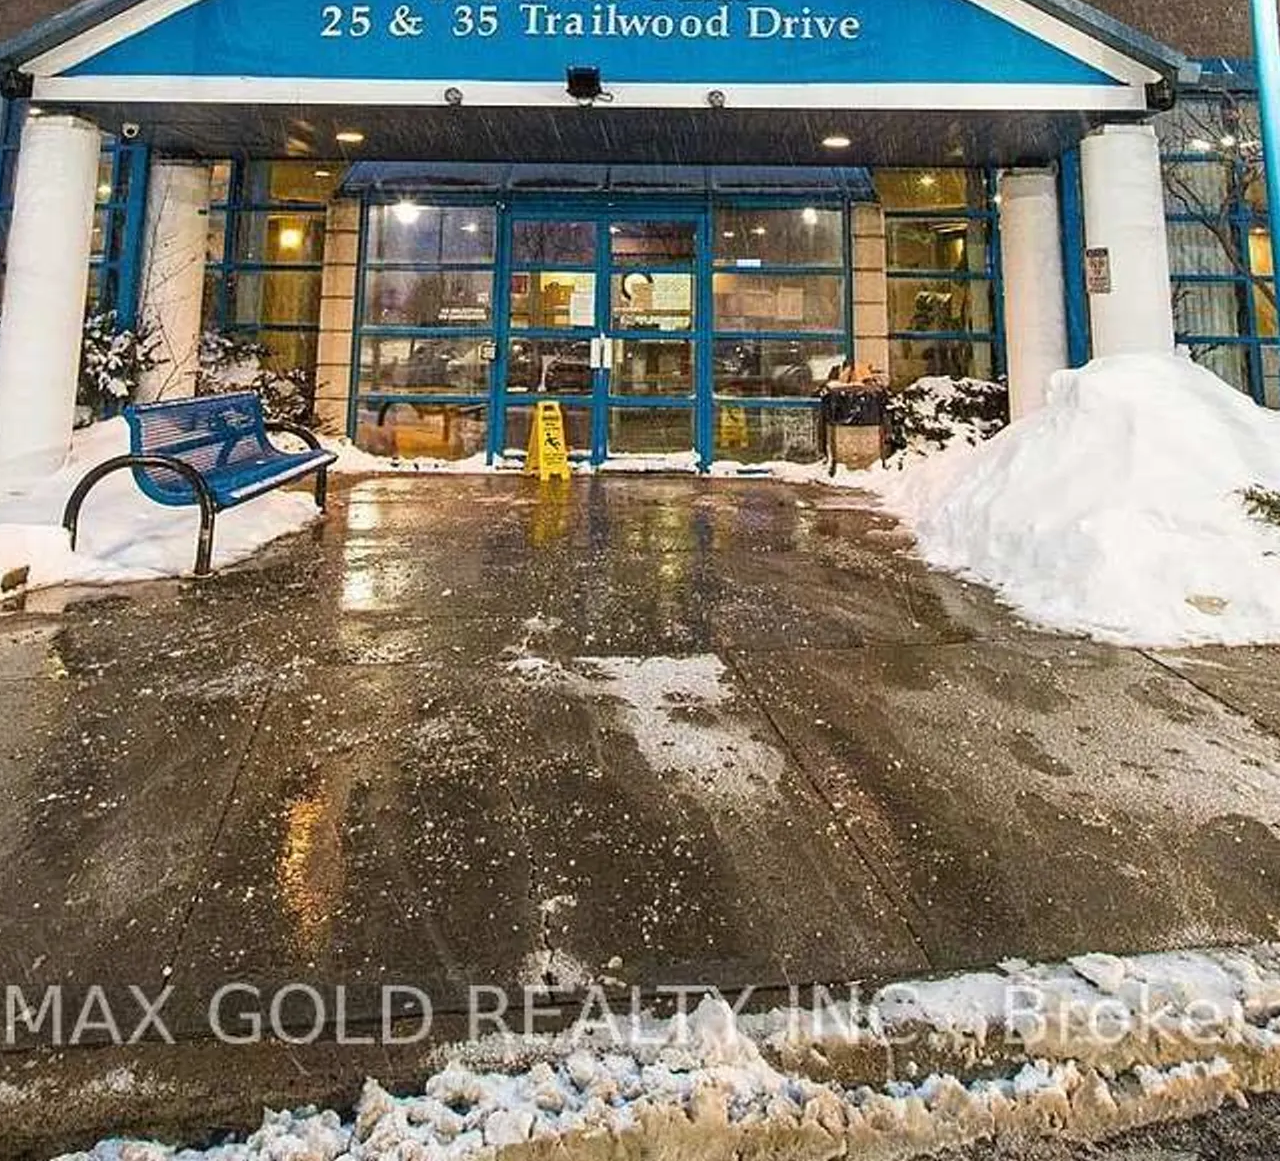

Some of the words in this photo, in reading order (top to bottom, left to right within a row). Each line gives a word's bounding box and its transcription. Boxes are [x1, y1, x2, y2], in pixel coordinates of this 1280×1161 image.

[320, 5, 372, 38] 25
[388, 5, 423, 37] &
[453, 5, 498, 37] 35
[520, 4, 729, 38] Trailwood
[747, 7, 860, 39] Drive
